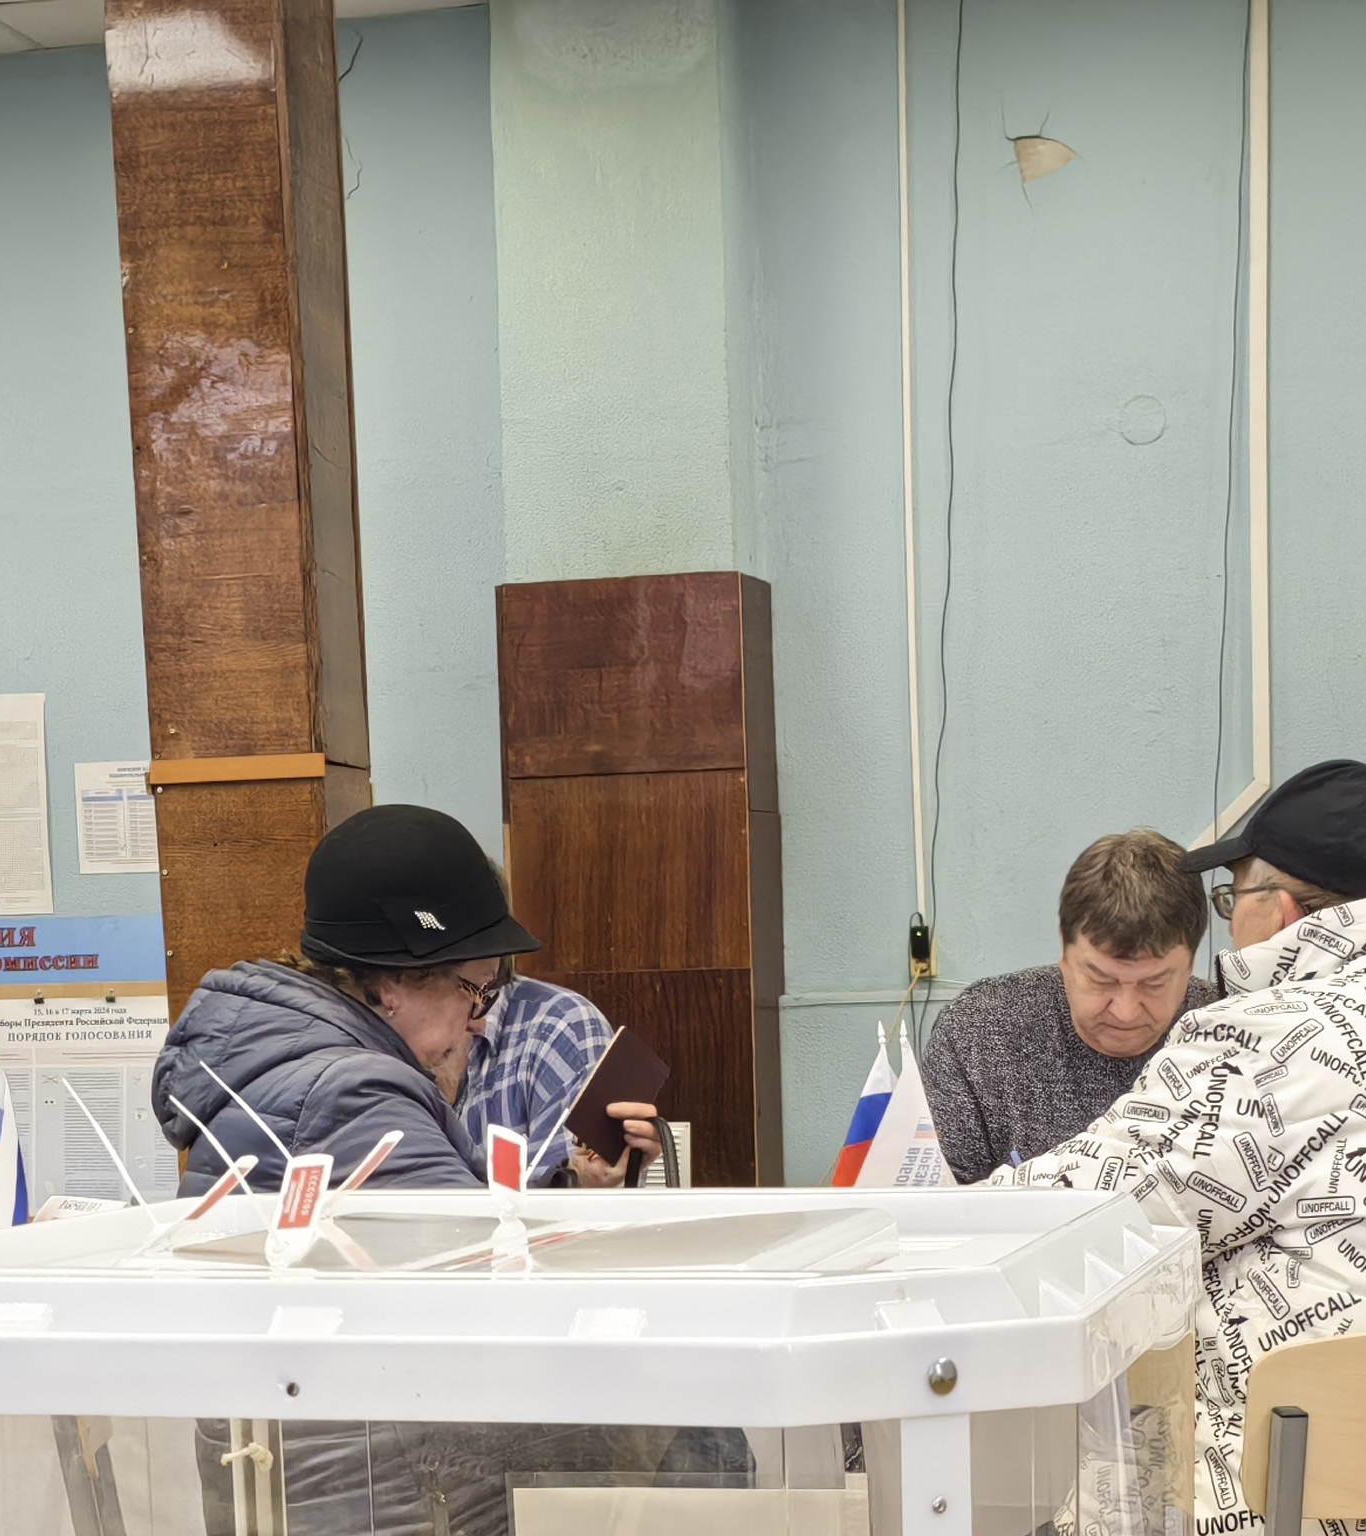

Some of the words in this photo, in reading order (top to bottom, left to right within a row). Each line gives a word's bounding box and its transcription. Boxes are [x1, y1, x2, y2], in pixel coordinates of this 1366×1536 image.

[7, 1032, 62, 1042] ПОРЯДОК
[65, 1030, 153, 1041] ГОЛОСОВАНИЯ
[24, 1018, 74, 1028] Президента
[1276, 1024, 1319, 1057] UNOFFCALL
[1186, 1046, 1240, 1079] UNOFFCALL
[1162, 1063, 1185, 1096] UNOFFCALL
[1127, 1105, 1166, 1120] UNOFFCALL
[1193, 1066, 1229, 1159] UNOFFCALL
[1239, 1137, 1268, 1187] UNOFFCALL
[1268, 1112, 1348, 1204] UNOFFCALL
[1327, 1138, 1348, 1194] UNOFFCALL
[1192, 1176, 1240, 1209] UNOFFCALL
[1301, 1202, 1351, 1213] UNOFFCALL
[1251, 1271, 1283, 1315] UNOFFCALL
[1258, 1293, 1362, 1351] UNOFFCALL
[1209, 1453, 1232, 1505] UNOFFCALL
[1197, 1510, 1265, 1536] UNOFF
